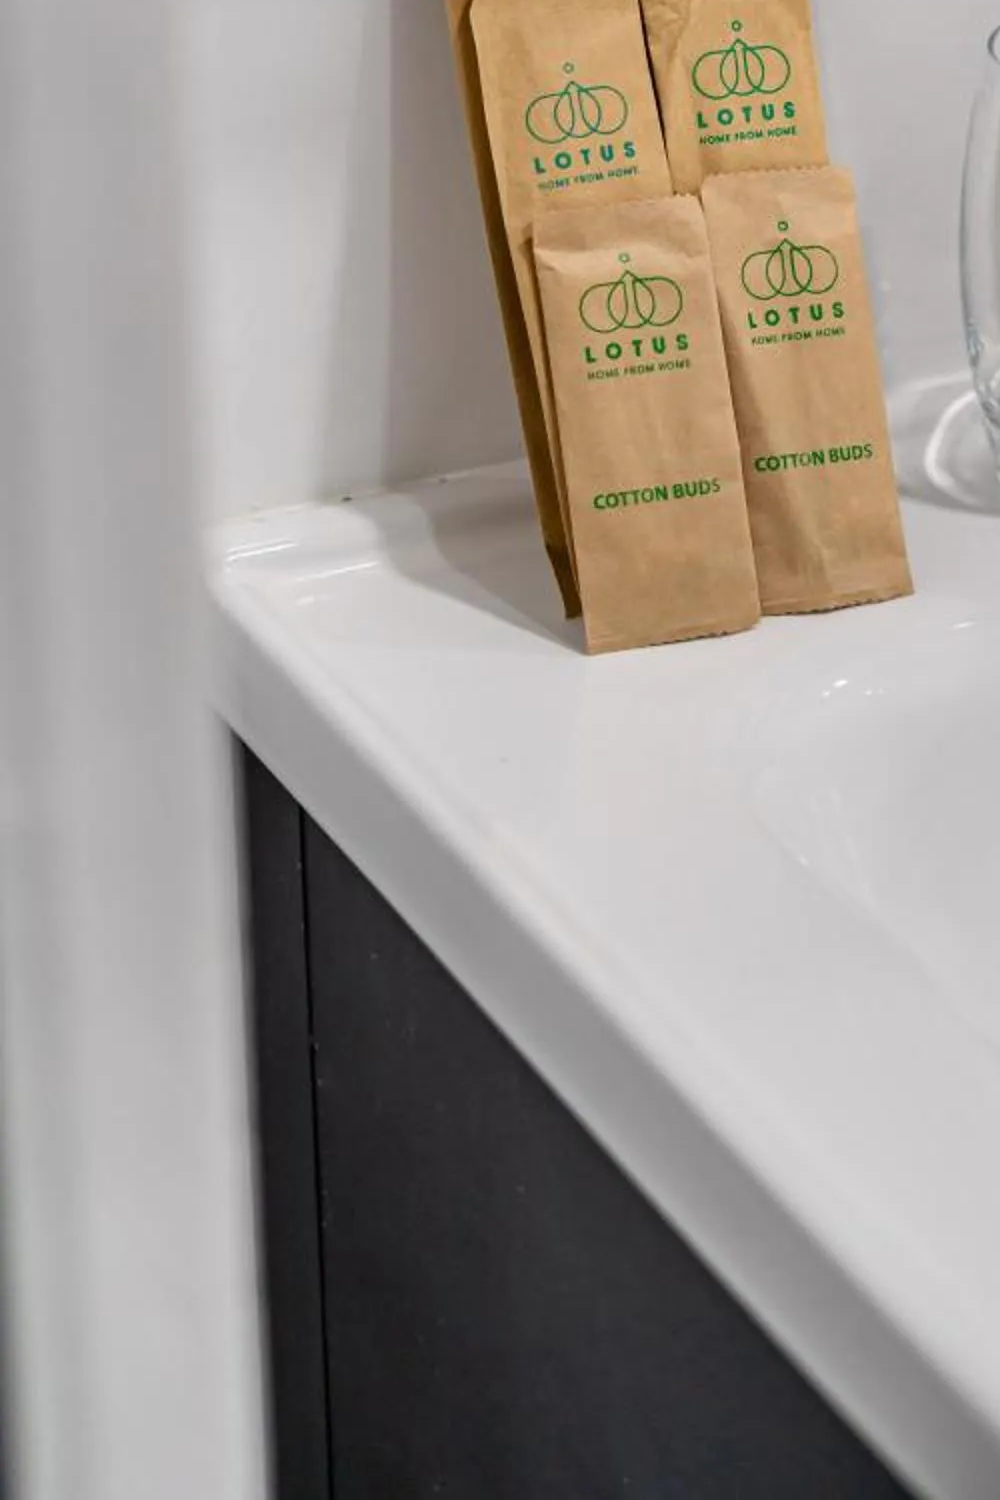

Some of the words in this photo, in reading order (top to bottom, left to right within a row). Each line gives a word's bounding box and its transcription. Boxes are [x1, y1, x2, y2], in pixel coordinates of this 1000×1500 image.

[697, 101, 795, 128] LOTUS
[534, 141, 636, 174] LOTUS
[748, 301, 845, 329] LOTUS
[585, 333, 689, 363] LOTUS
[754, 450, 825, 472] COTTON
[829, 443, 873, 463] BUDS
[593, 484, 668, 510] COTTON
[673, 478, 721, 499] BUDS
